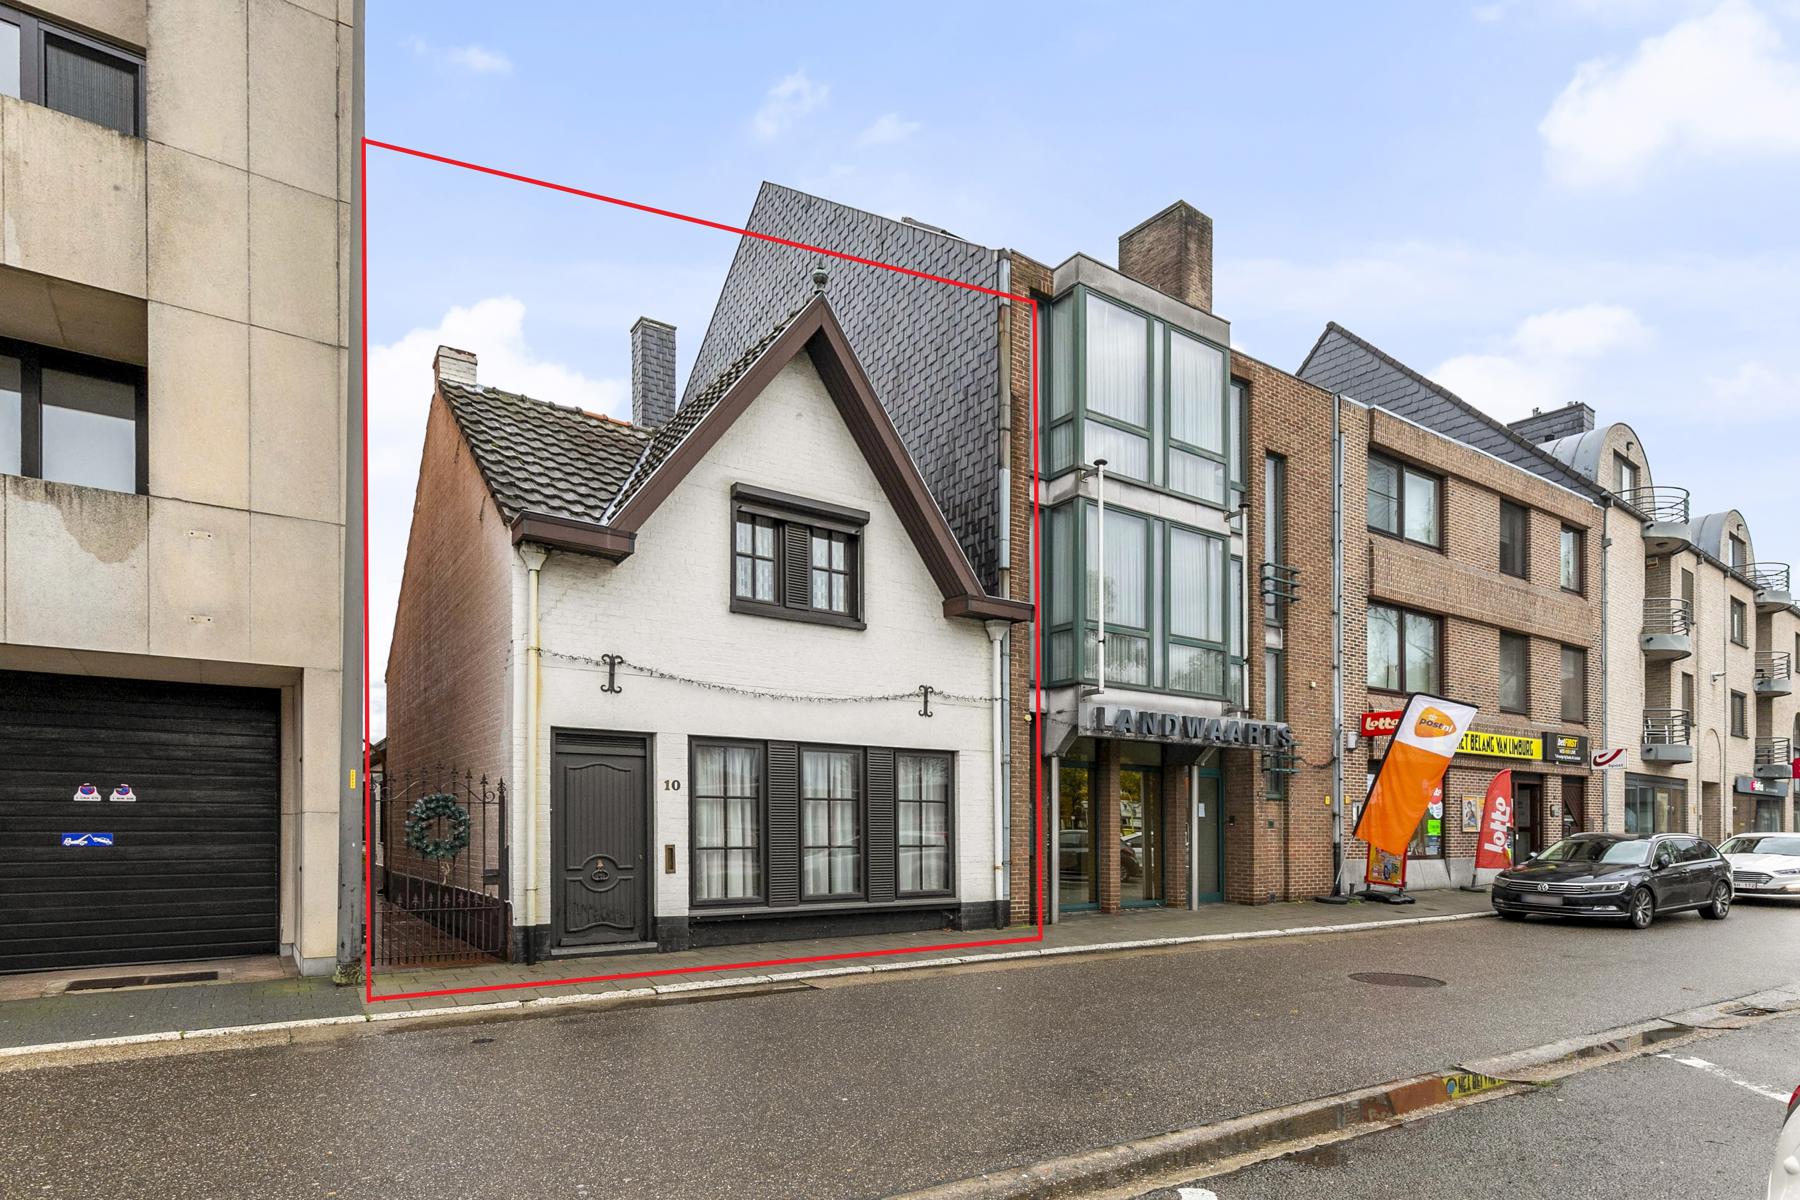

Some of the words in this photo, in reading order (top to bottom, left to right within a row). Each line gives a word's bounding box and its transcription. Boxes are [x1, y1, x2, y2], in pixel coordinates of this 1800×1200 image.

[1095, 706, 1293, 747] LANDWAARTS
[1365, 716, 1399, 731] Lotto
[1419, 718, 1453, 733] postnl
[1470, 733, 1495, 752] BELANG
[1496, 736, 1508, 754] VAN
[1509, 738, 1534, 756] LIMBURG
[664, 779, 681, 791] 10
